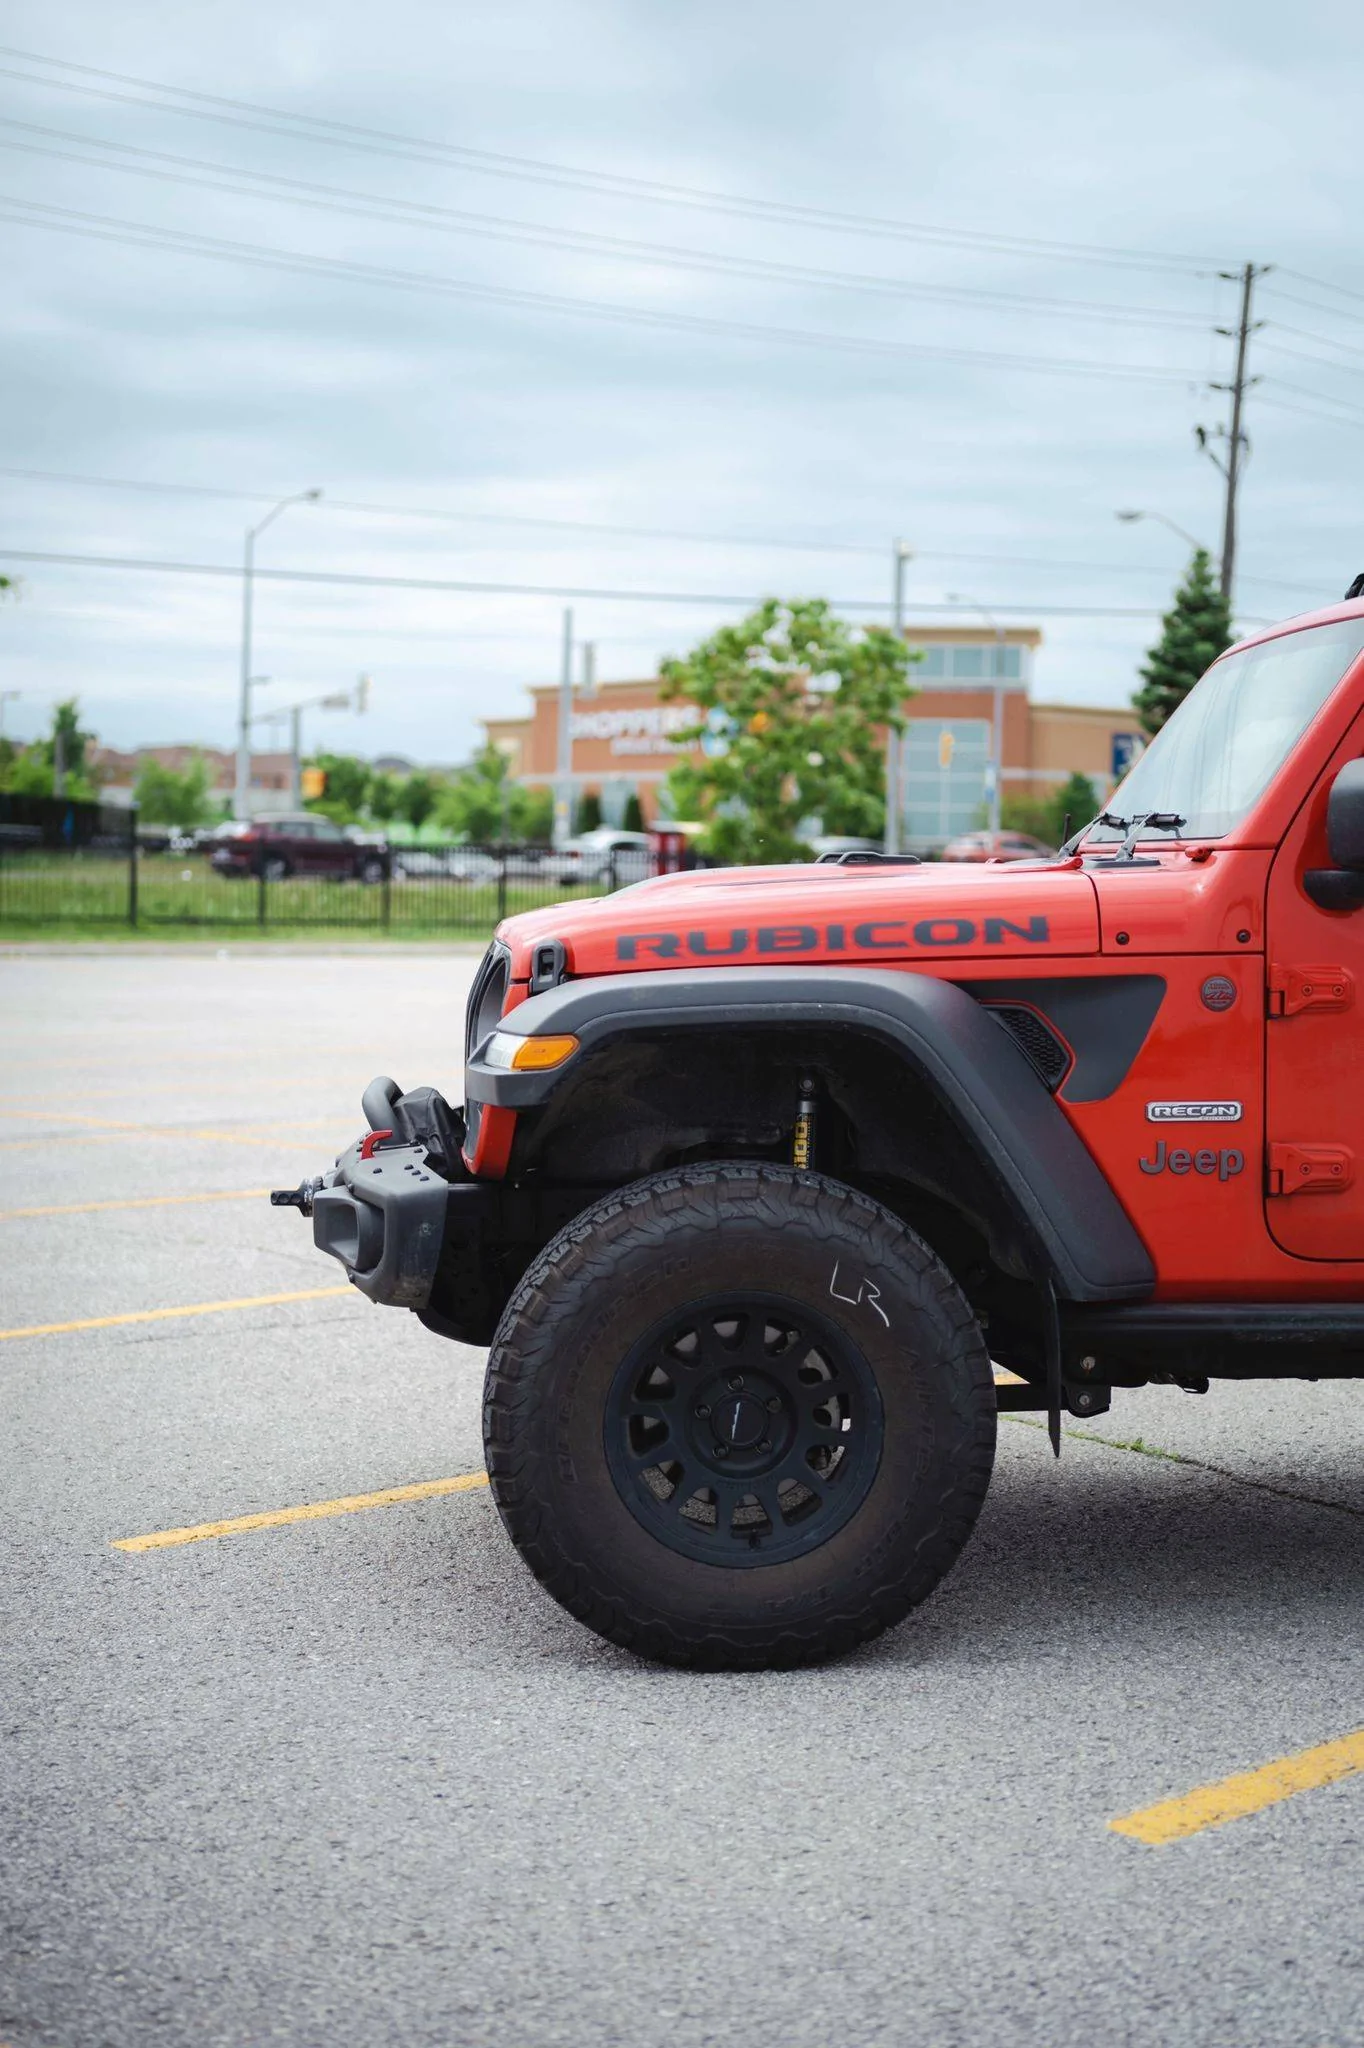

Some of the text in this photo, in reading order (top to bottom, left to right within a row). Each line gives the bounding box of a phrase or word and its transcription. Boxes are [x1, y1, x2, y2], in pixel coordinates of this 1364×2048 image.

[616, 916, 1050, 960] RUBICON
[1154, 1105, 1236, 1117] RECON
[1139, 1140, 1244, 1181] Jeep
[830, 1259, 890, 1328] LR
